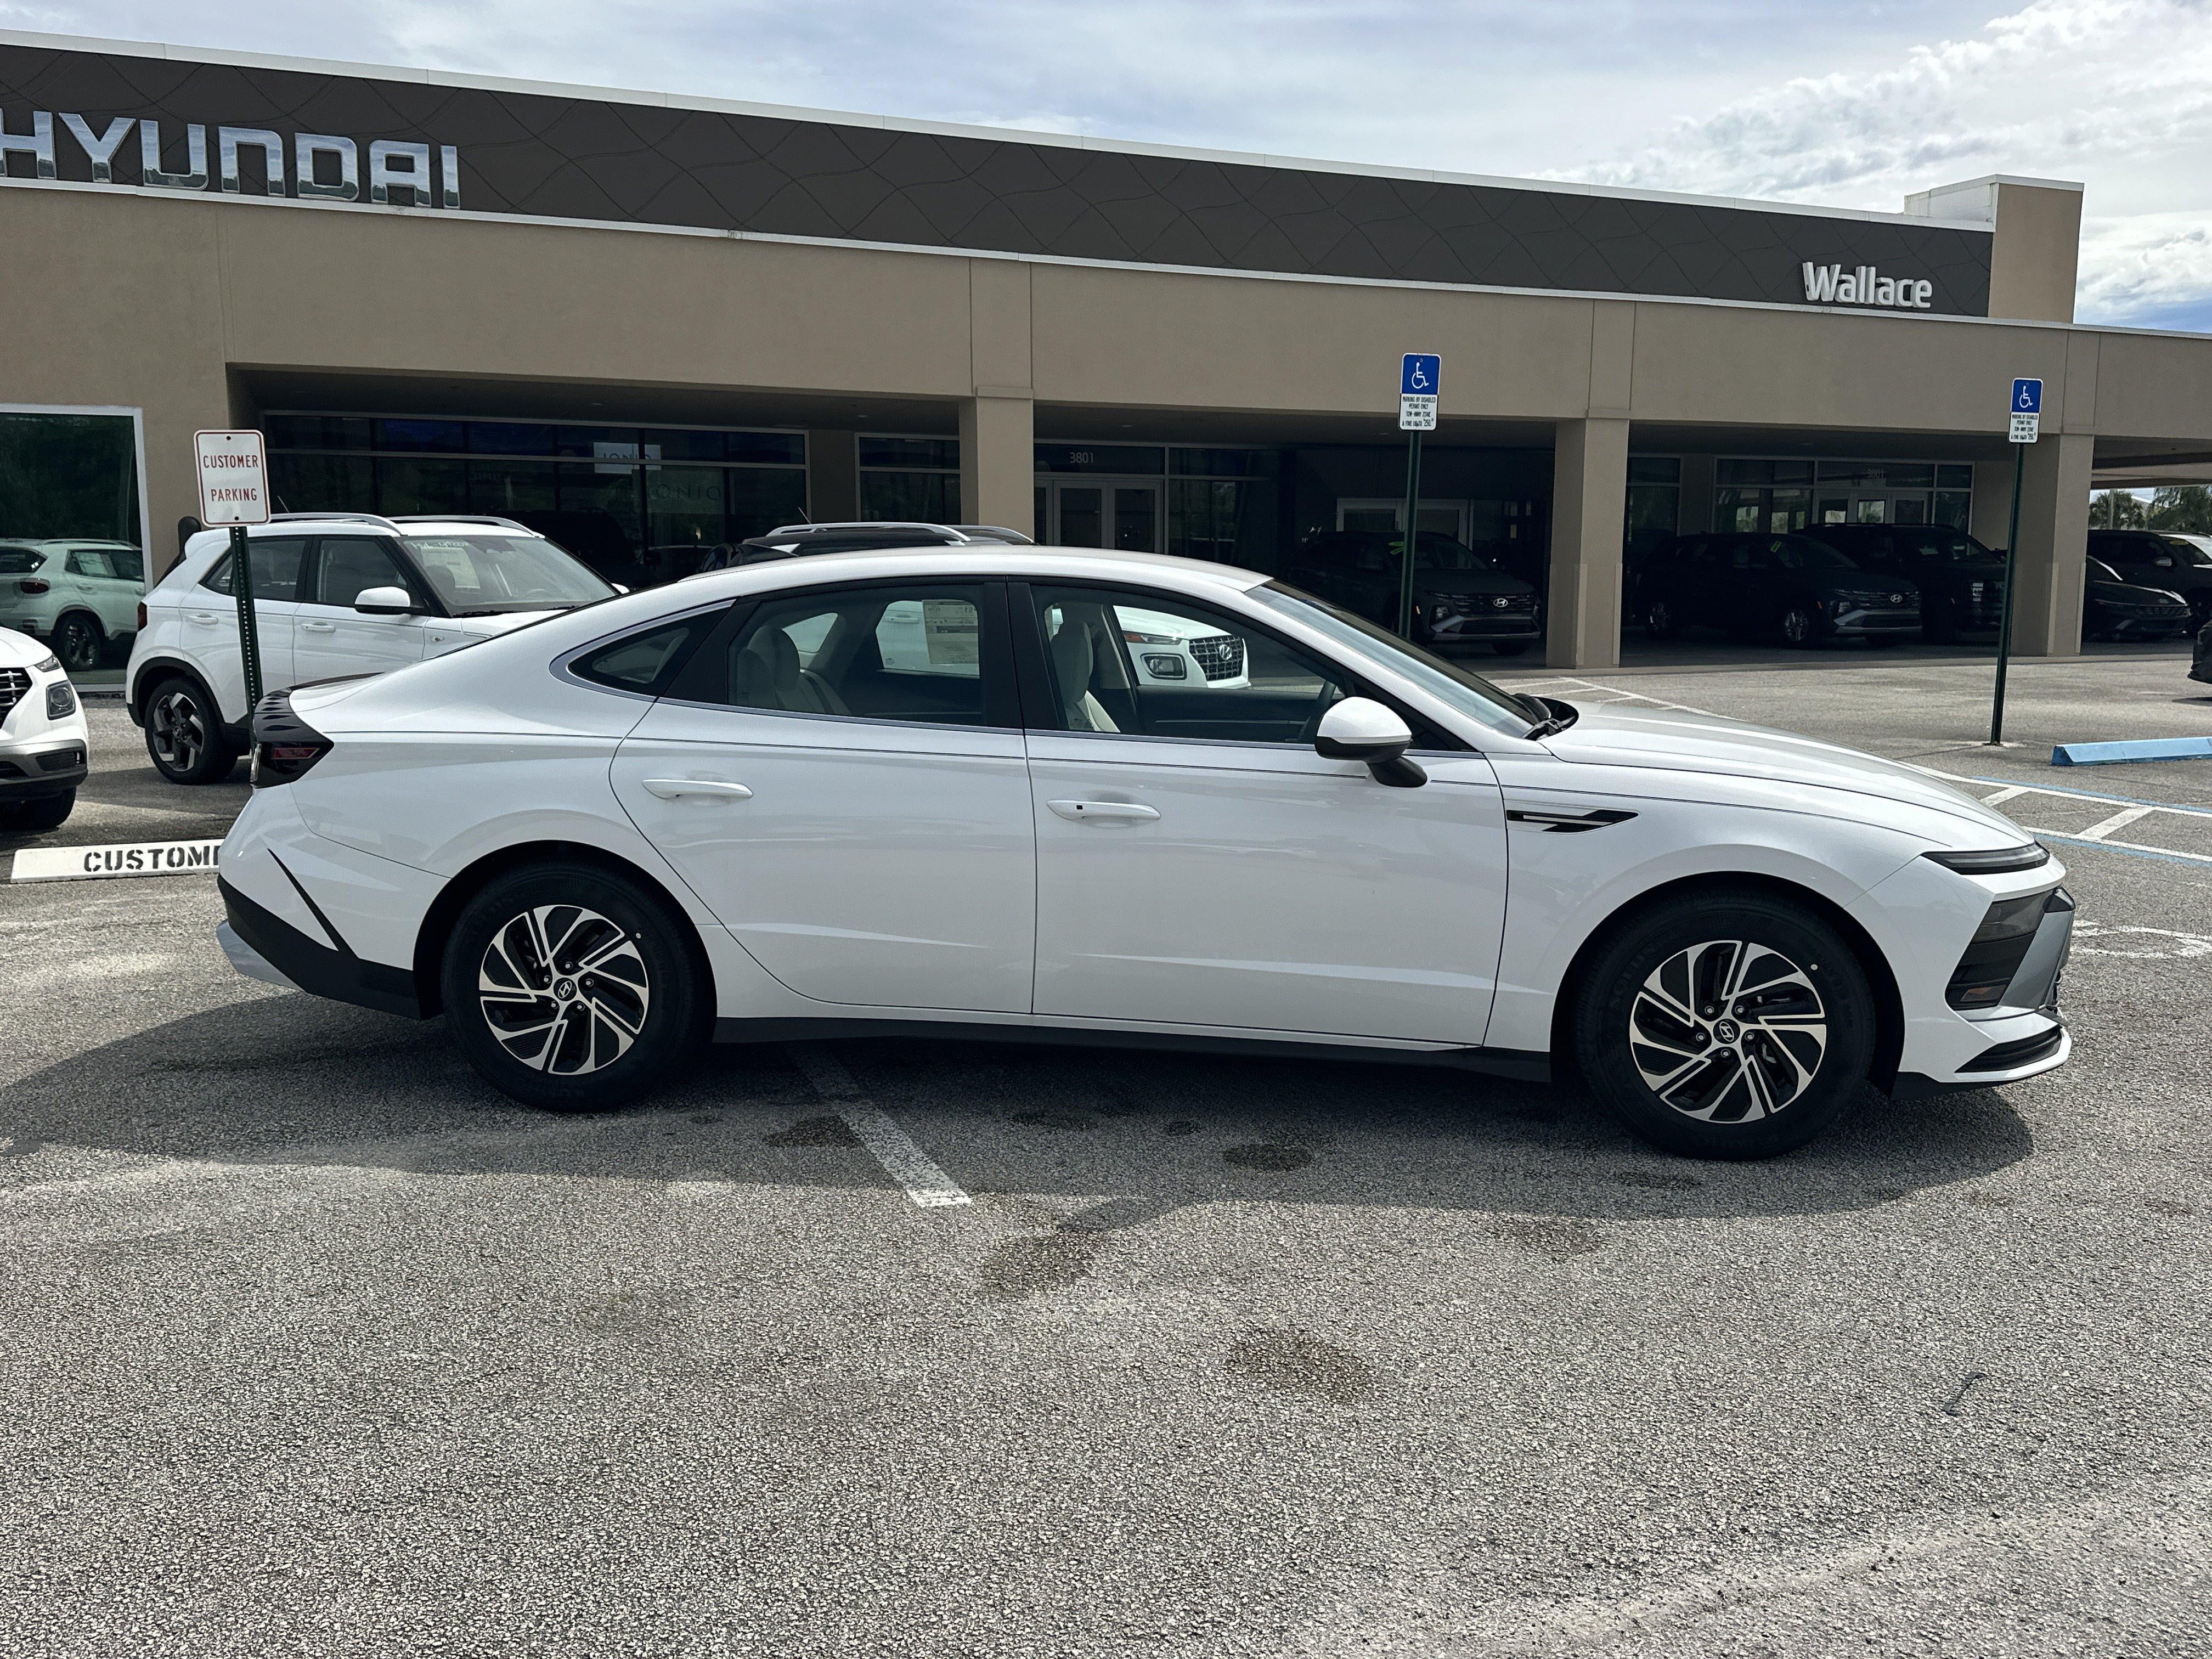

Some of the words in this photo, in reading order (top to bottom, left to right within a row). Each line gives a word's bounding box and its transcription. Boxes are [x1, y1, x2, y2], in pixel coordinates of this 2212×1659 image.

[0, 108, 461, 210] HYUNDAI
[1802, 261, 1933, 308] Wallace
[202, 455, 259, 469] CUSTOMER
[1070, 452, 1094, 464] 3801
[211, 488, 257, 502] PARKING
